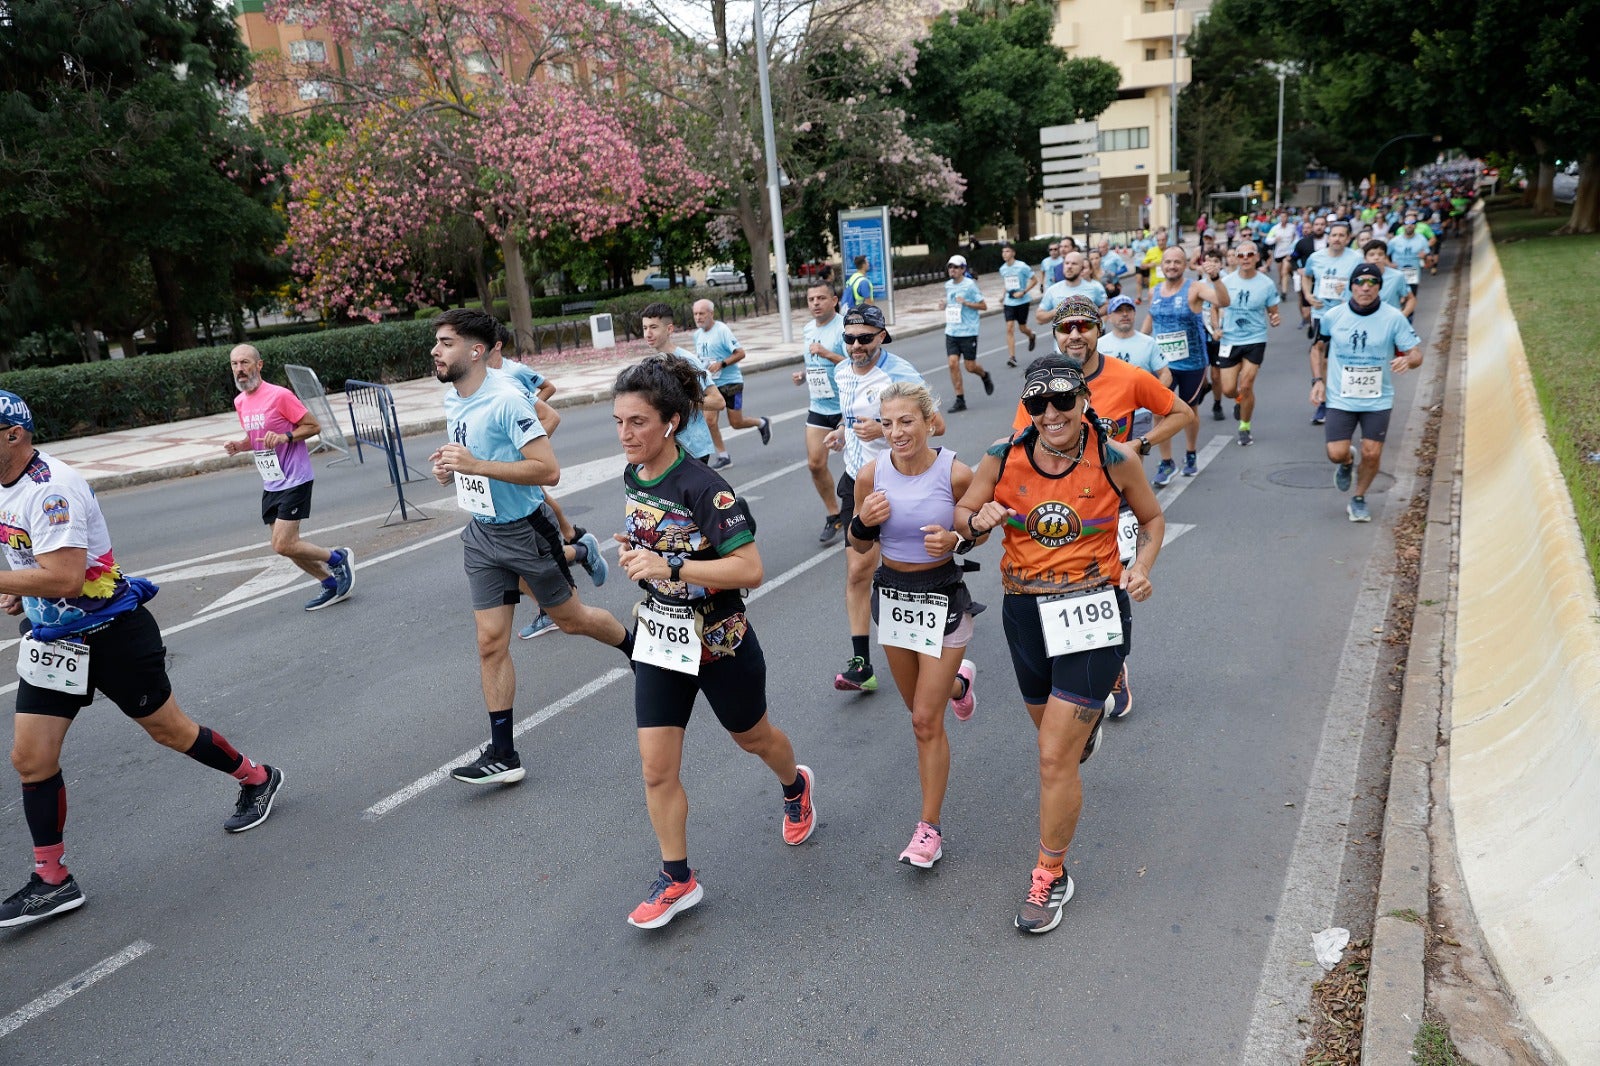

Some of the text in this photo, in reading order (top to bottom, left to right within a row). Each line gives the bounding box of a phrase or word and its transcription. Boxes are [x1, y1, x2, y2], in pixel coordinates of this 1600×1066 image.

[1348, 376, 1376, 385] 3425
[257, 459, 275, 469] 1134
[460, 475, 485, 495] 1346
[1037, 503, 1070, 516] BEER
[892, 606, 936, 628] 6513
[1058, 600, 1114, 628] 1198
[648, 619, 690, 644] 9768
[29, 648, 77, 672] 9576
